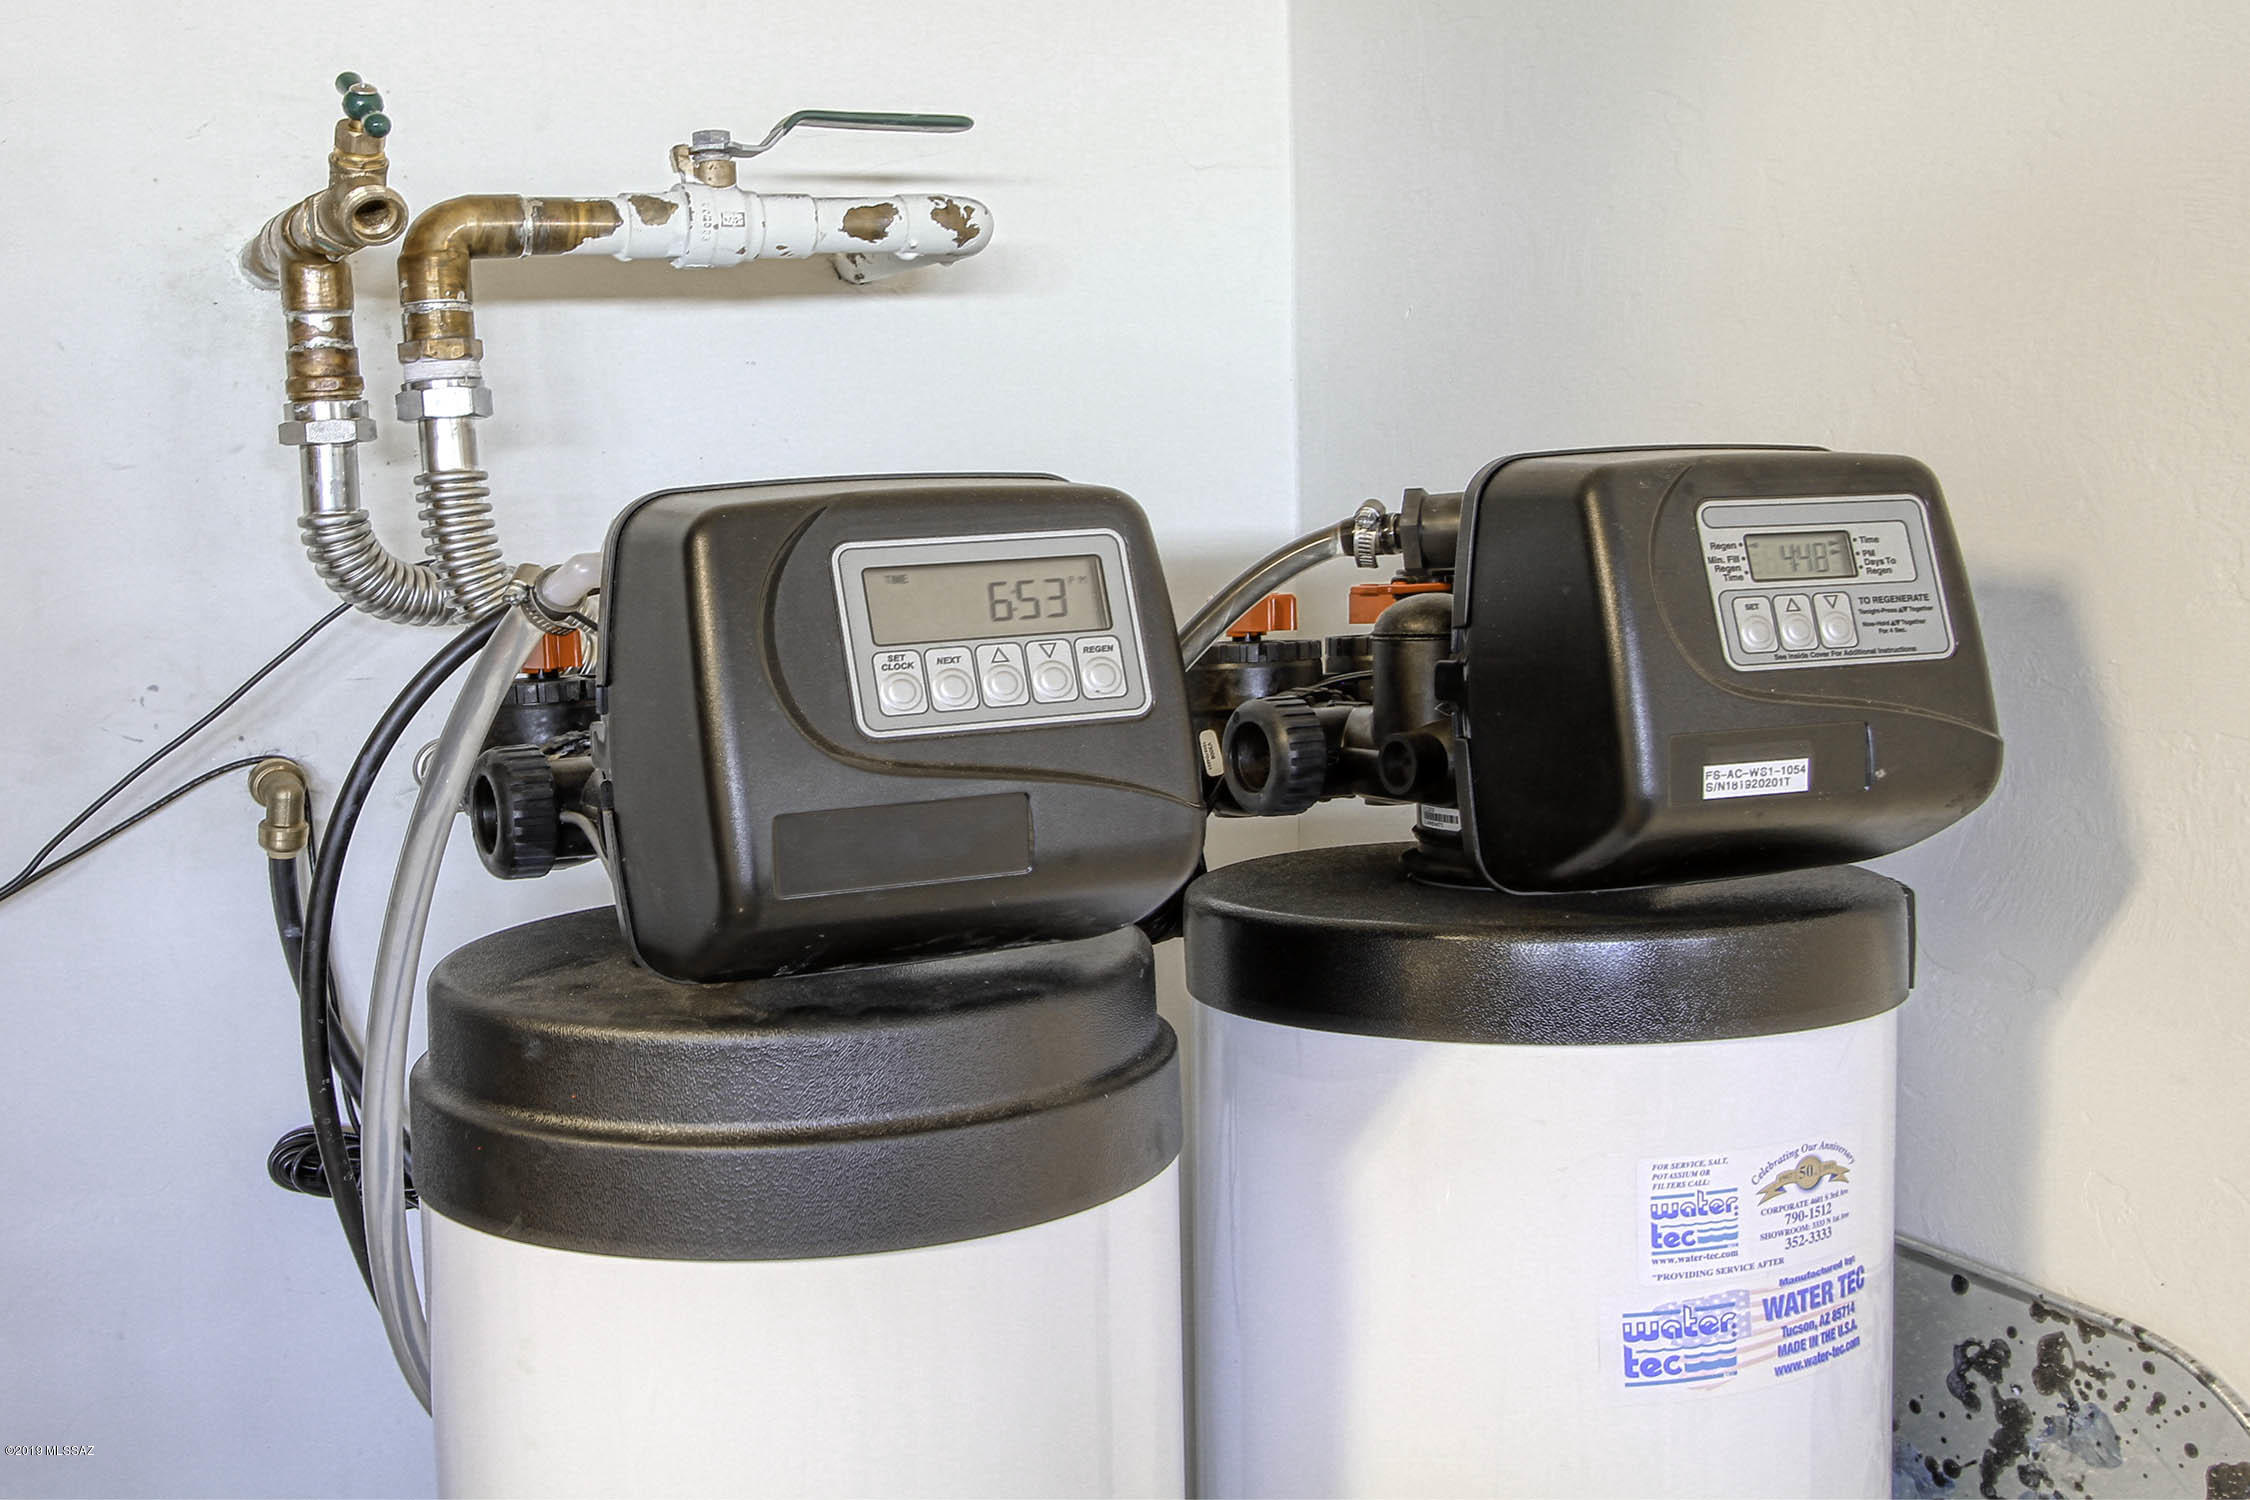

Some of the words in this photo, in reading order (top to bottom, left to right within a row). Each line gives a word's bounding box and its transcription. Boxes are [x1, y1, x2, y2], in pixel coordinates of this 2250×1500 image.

[1859, 535, 1880, 543] Time
[1710, 542, 1737, 551] Regen
[1862, 549, 1875, 557] PM
[1708, 556, 1725, 564] Min.
[1727, 555, 1740, 563] Fill
[1864, 558, 1885, 567] Days
[1884, 556, 1897, 565] To
[1713, 564, 1742, 573] Regen
[1866, 566, 1893, 576] Regen
[885, 574, 909, 585] TIME
[1723, 573, 1744, 582] Time
[1858, 596, 1871, 605] TO
[1872, 593, 1930, 604] REGENERATE
[1083, 643, 1114, 654] REGEN
[1774, 653, 1787, 661] See
[1789, 652, 1809, 660] Inside
[1810, 651, 1830, 659] Cover
[1843, 648, 1877, 656] Additional
[1878, 645, 1917, 654] Instructions
[887, 653, 906, 663] SET
[936, 655, 962, 666] NEXT
[881, 661, 914, 672] CLOCK
[1652, 1163, 1669, 1171] FOR
[1751, 1148, 1800, 1186] Celebrating
[1801, 1143, 1818, 1153] Our
[1799, 1164, 1814, 1179] 50
[1652, 1169, 1699, 1181] POTASSIUM
[1700, 1168, 1711, 1176] OR
[1652, 1180, 1686, 1191] FILTERS
[1650, 1189, 1739, 1220] water
[1760, 1200, 1809, 1216] CORPORATE
[1784, 1201, 1833, 1225] 790-1512
[1650, 1222, 1697, 1249] tec
[1784, 1226, 1833, 1250] 352-3333
[1651, 1250, 1739, 1265] www.water-tec.com
[1715, 1262, 1756, 1276] SERVICE
[1757, 1257, 1785, 1269] AFTER
[1778, 1260, 1843, 1287] Manufactured
[1762, 1280, 1834, 1322] WATER
[1837, 1264, 1865, 1299] TEC
[1622, 1305, 1737, 1343] water
[1781, 1320, 1818, 1338] Tucson,
[1819, 1312, 1831, 1327] AZ
[1831, 1301, 1856, 1322] 85714
[1777, 1338, 1807, 1358] MADE
[1808, 1334, 1818, 1349] IN
[1820, 1327, 1837, 1344] THE
[1623, 1345, 1683, 1379] tec
[1774, 1336, 1861, 1377] www.water-tec.com
